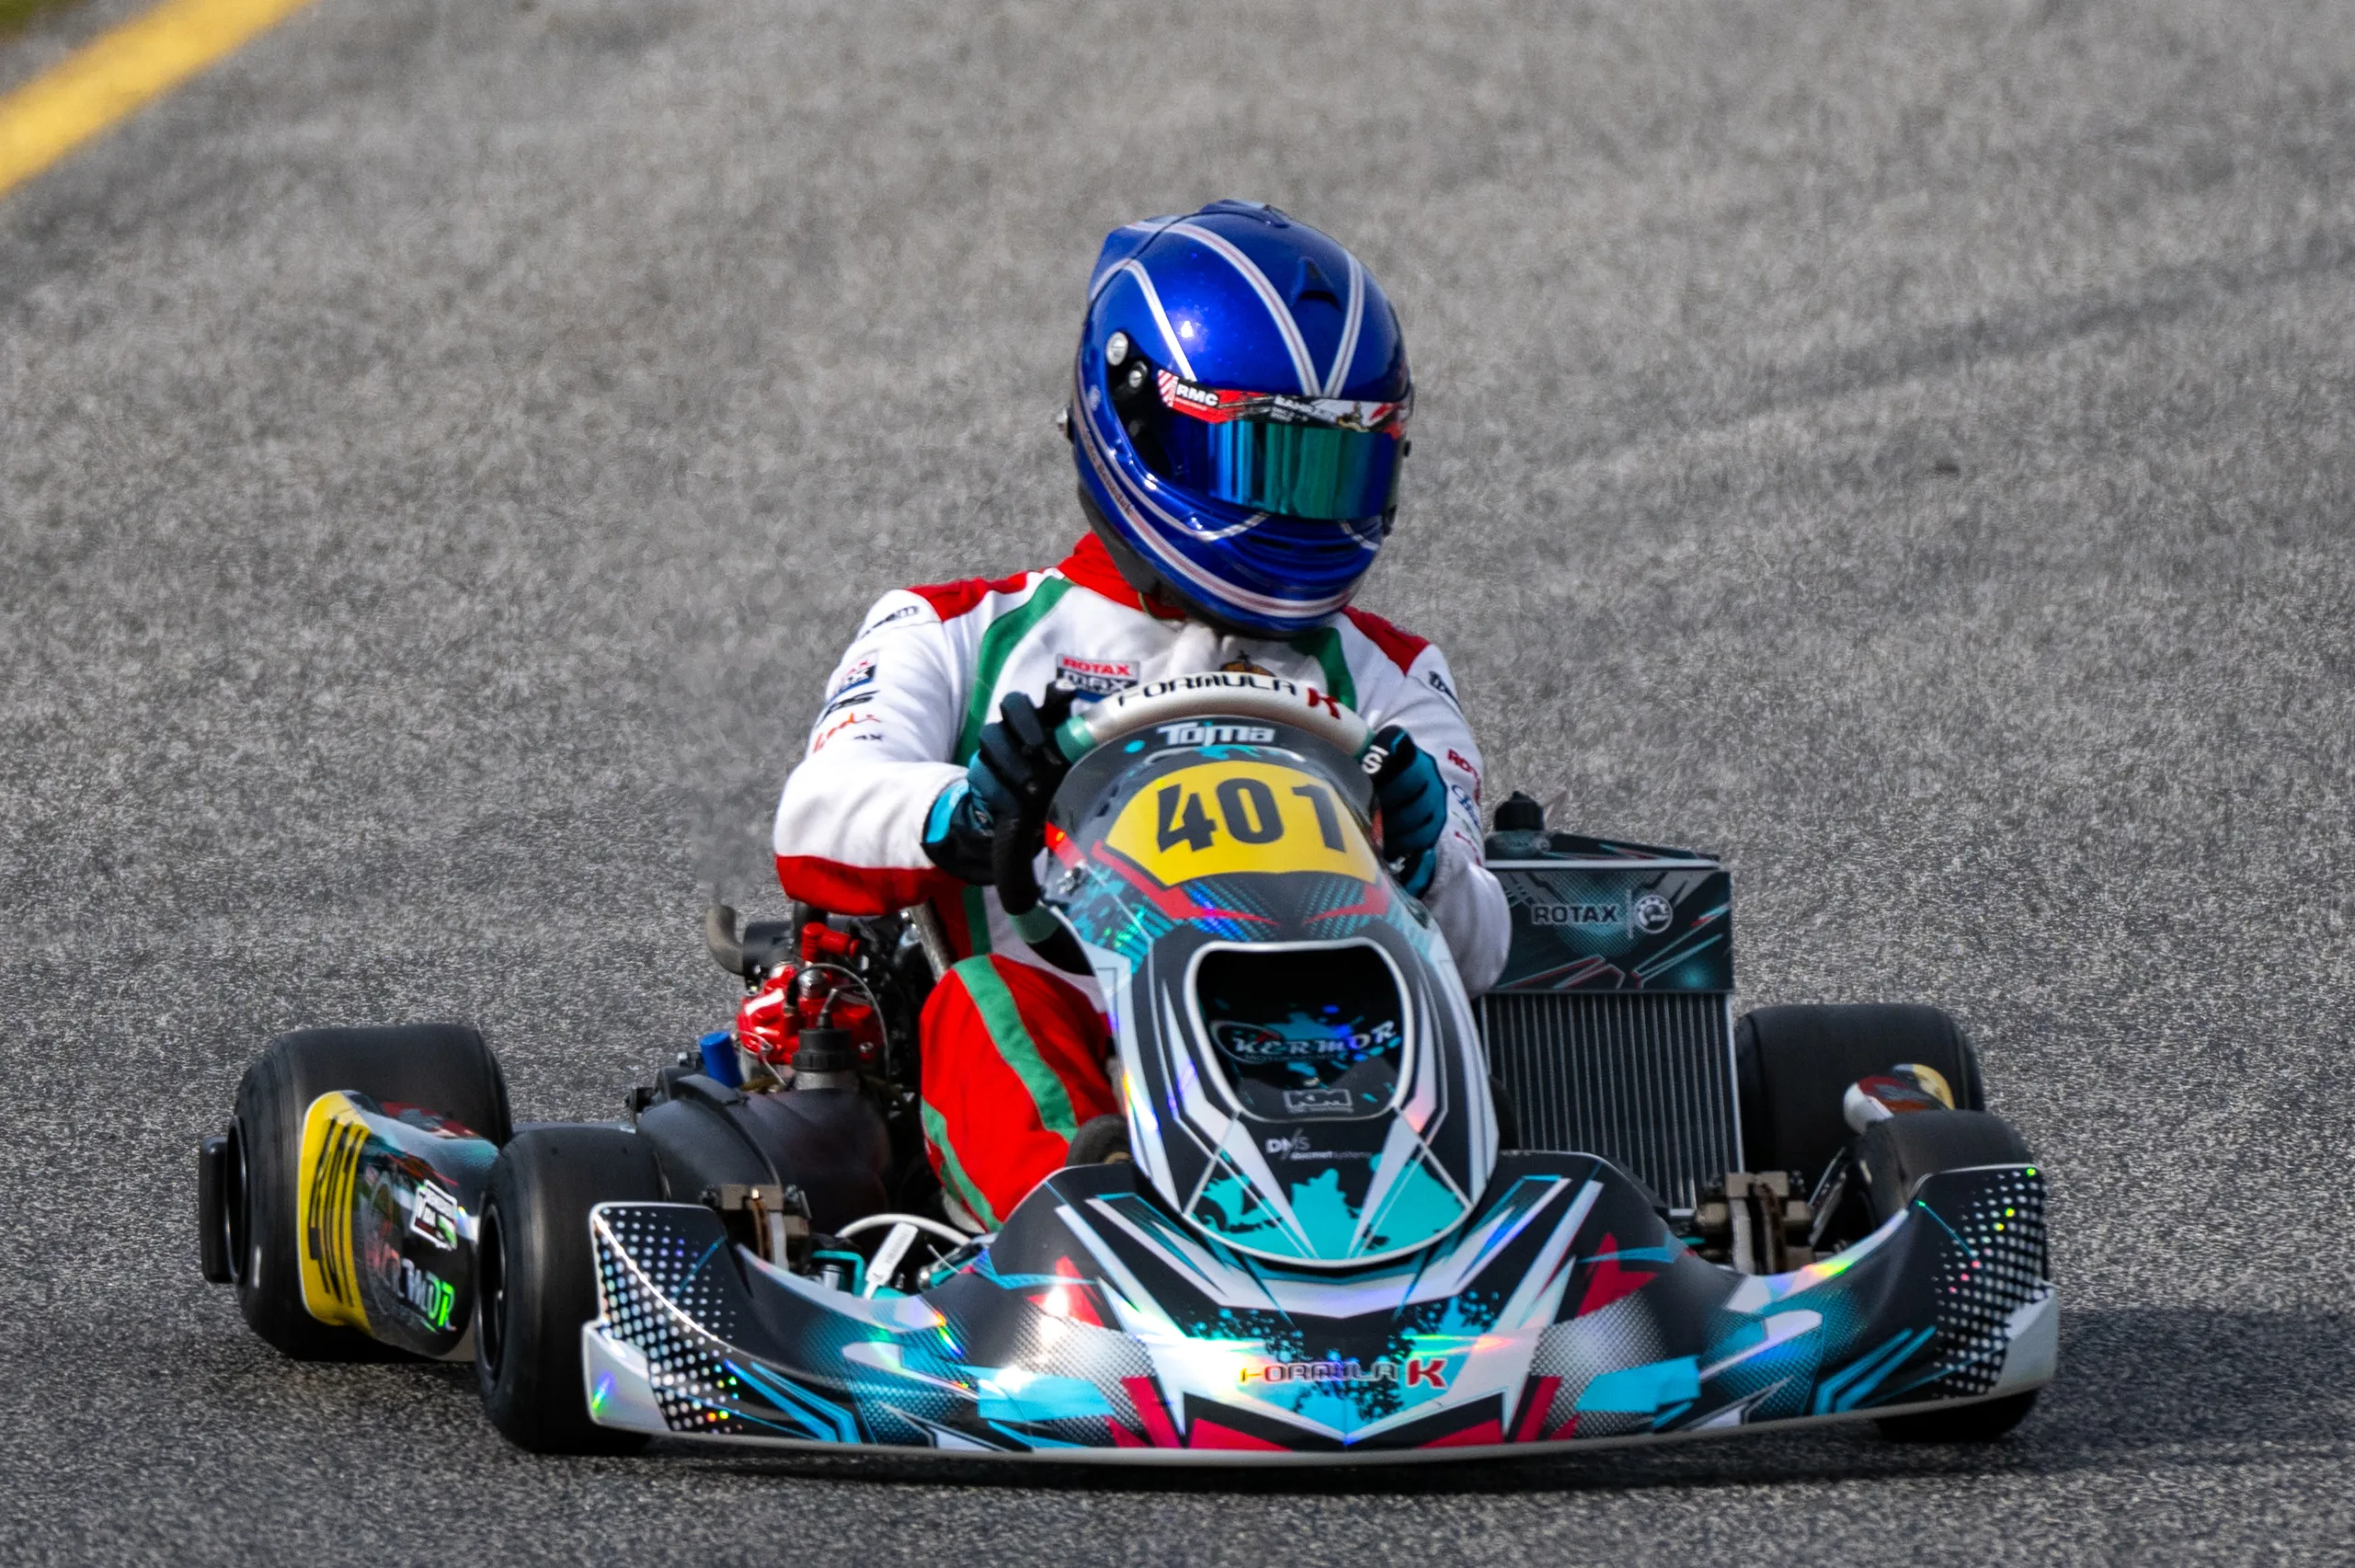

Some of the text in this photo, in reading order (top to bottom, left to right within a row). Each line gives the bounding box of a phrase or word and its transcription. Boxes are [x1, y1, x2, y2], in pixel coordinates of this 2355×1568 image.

[1176, 383, 1220, 406] RMC
[1063, 656, 1131, 675] ROTAX
[1118, 673, 1341, 720] FORMULA K
[1156, 721, 1276, 748] Tojma
[1156, 777, 1348, 855] 401
[1532, 904, 1622, 925] ROTAX
[1232, 1020, 1396, 1055] KERMOR
[1265, 1135, 1311, 1154] DMS
[1240, 1357, 1448, 1390] FORMULA K
